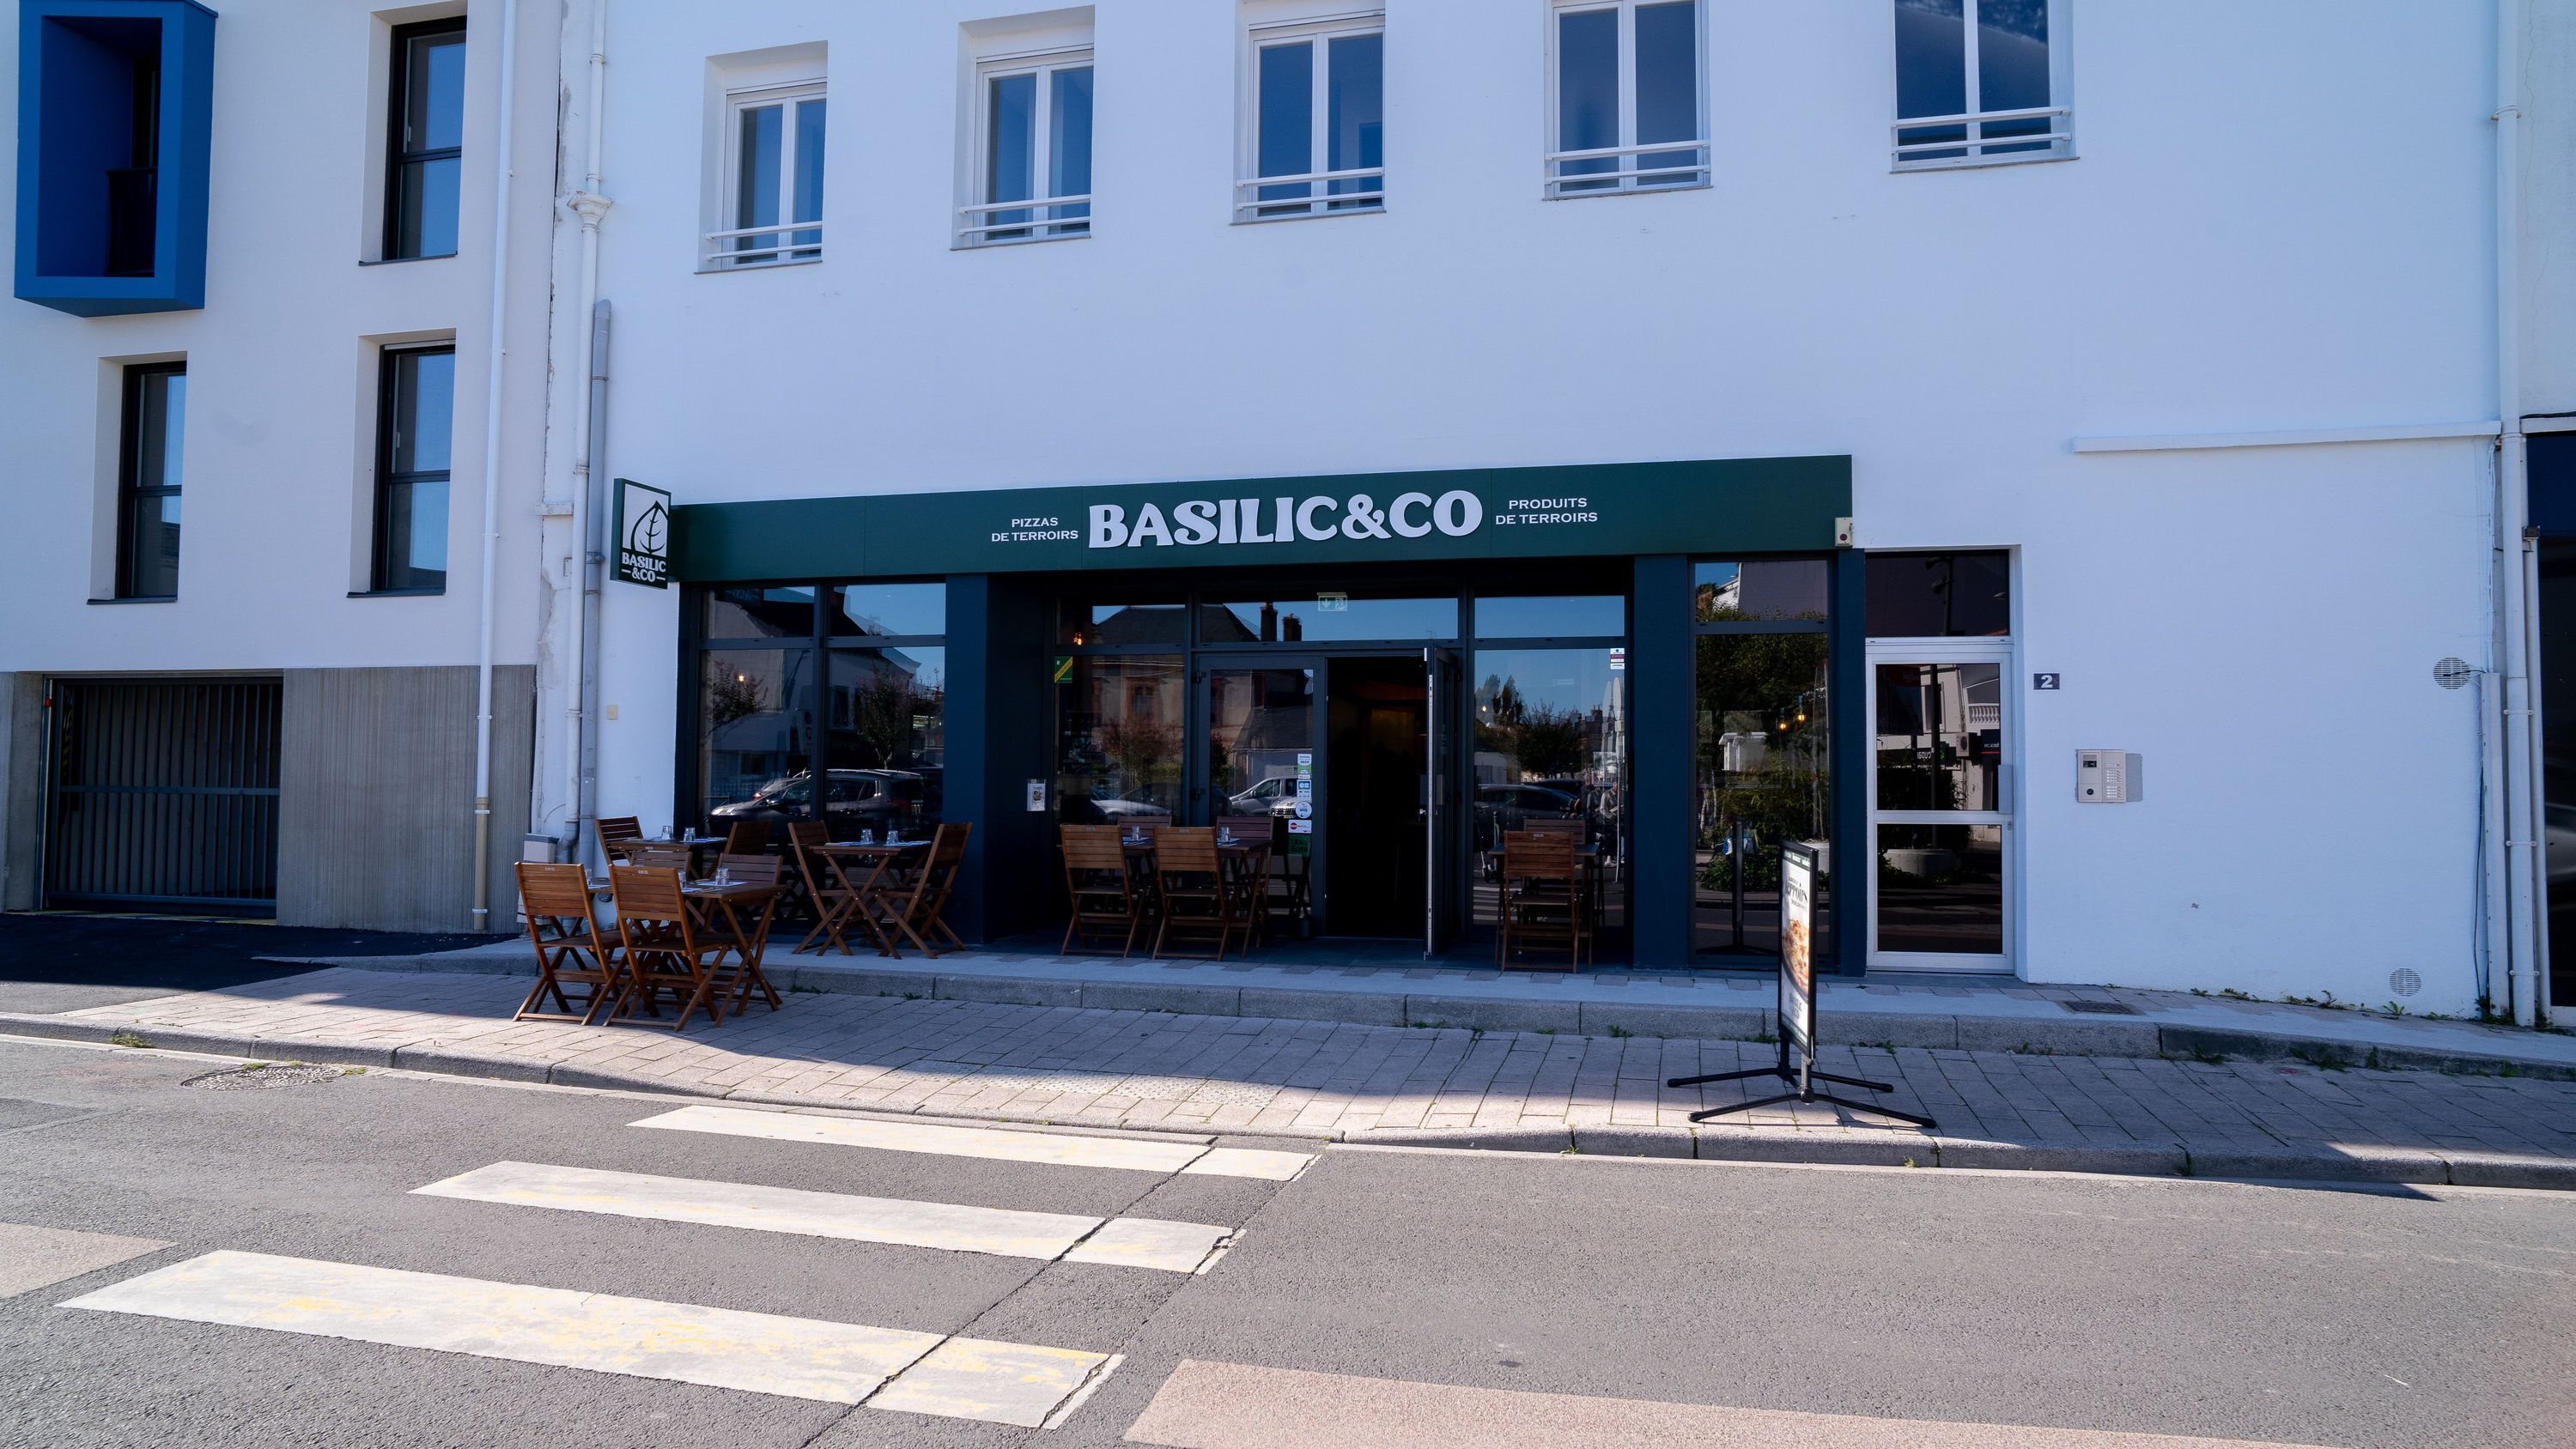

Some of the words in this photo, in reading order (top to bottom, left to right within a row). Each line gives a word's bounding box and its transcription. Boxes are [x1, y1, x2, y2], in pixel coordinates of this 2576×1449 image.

[1509, 498, 1588, 510] PRODUITS
[1012, 517, 1059, 528] PIZZAS
[1088, 489, 1484, 549] BASILIC&CO
[1495, 514, 1516, 525] DE
[1517, 512, 1598, 524] TERROIRS
[991, 531, 1010, 543] DE
[1011, 530, 1079, 542] TERROIRS
[622, 551, 667, 573] BASILIC
[631, 567, 656, 583] &CO
[2040, 674, 2053, 688] 2
